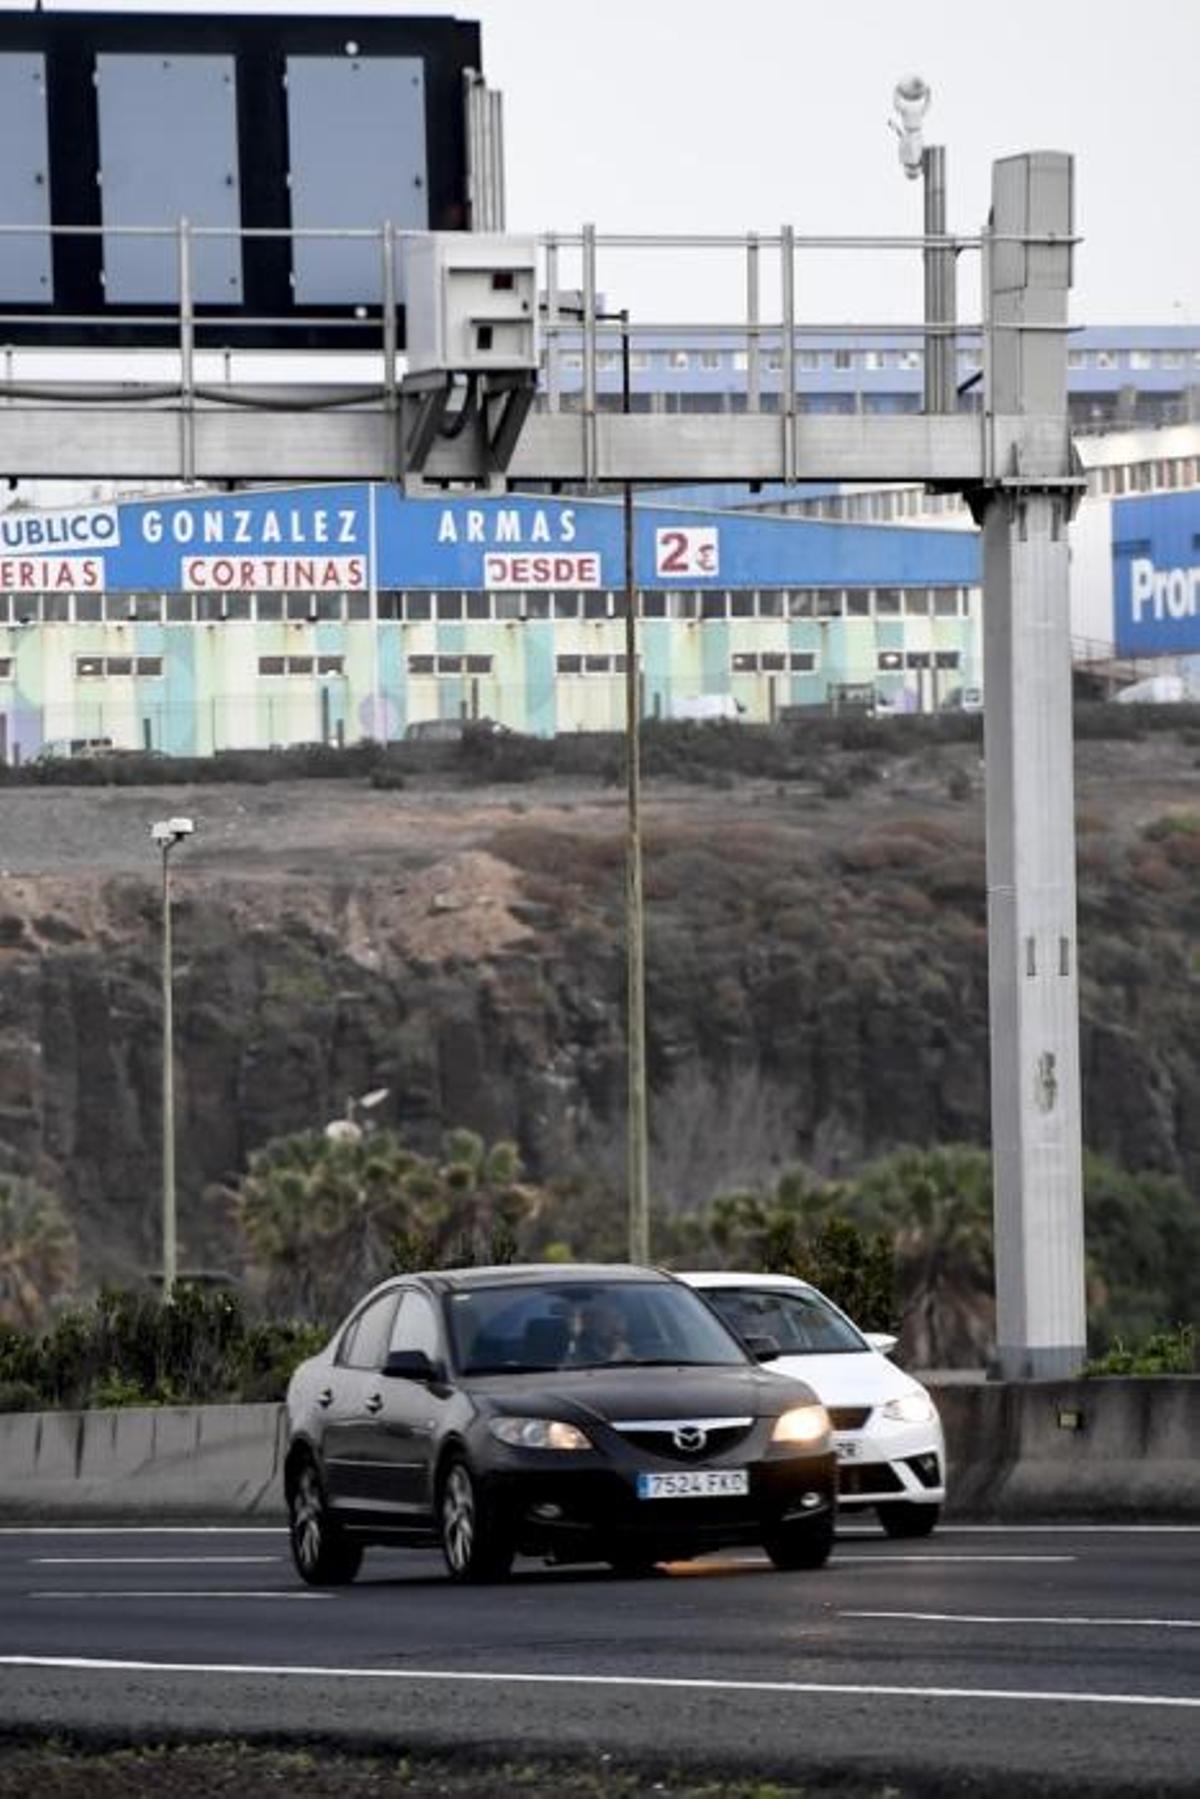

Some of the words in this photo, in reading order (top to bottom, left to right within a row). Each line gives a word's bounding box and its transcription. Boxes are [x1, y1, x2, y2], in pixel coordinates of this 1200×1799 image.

[142, 511, 357, 542] GONZALEZ
[437, 509, 577, 543] ARMAS
[188, 559, 364, 588] CORTINAS
